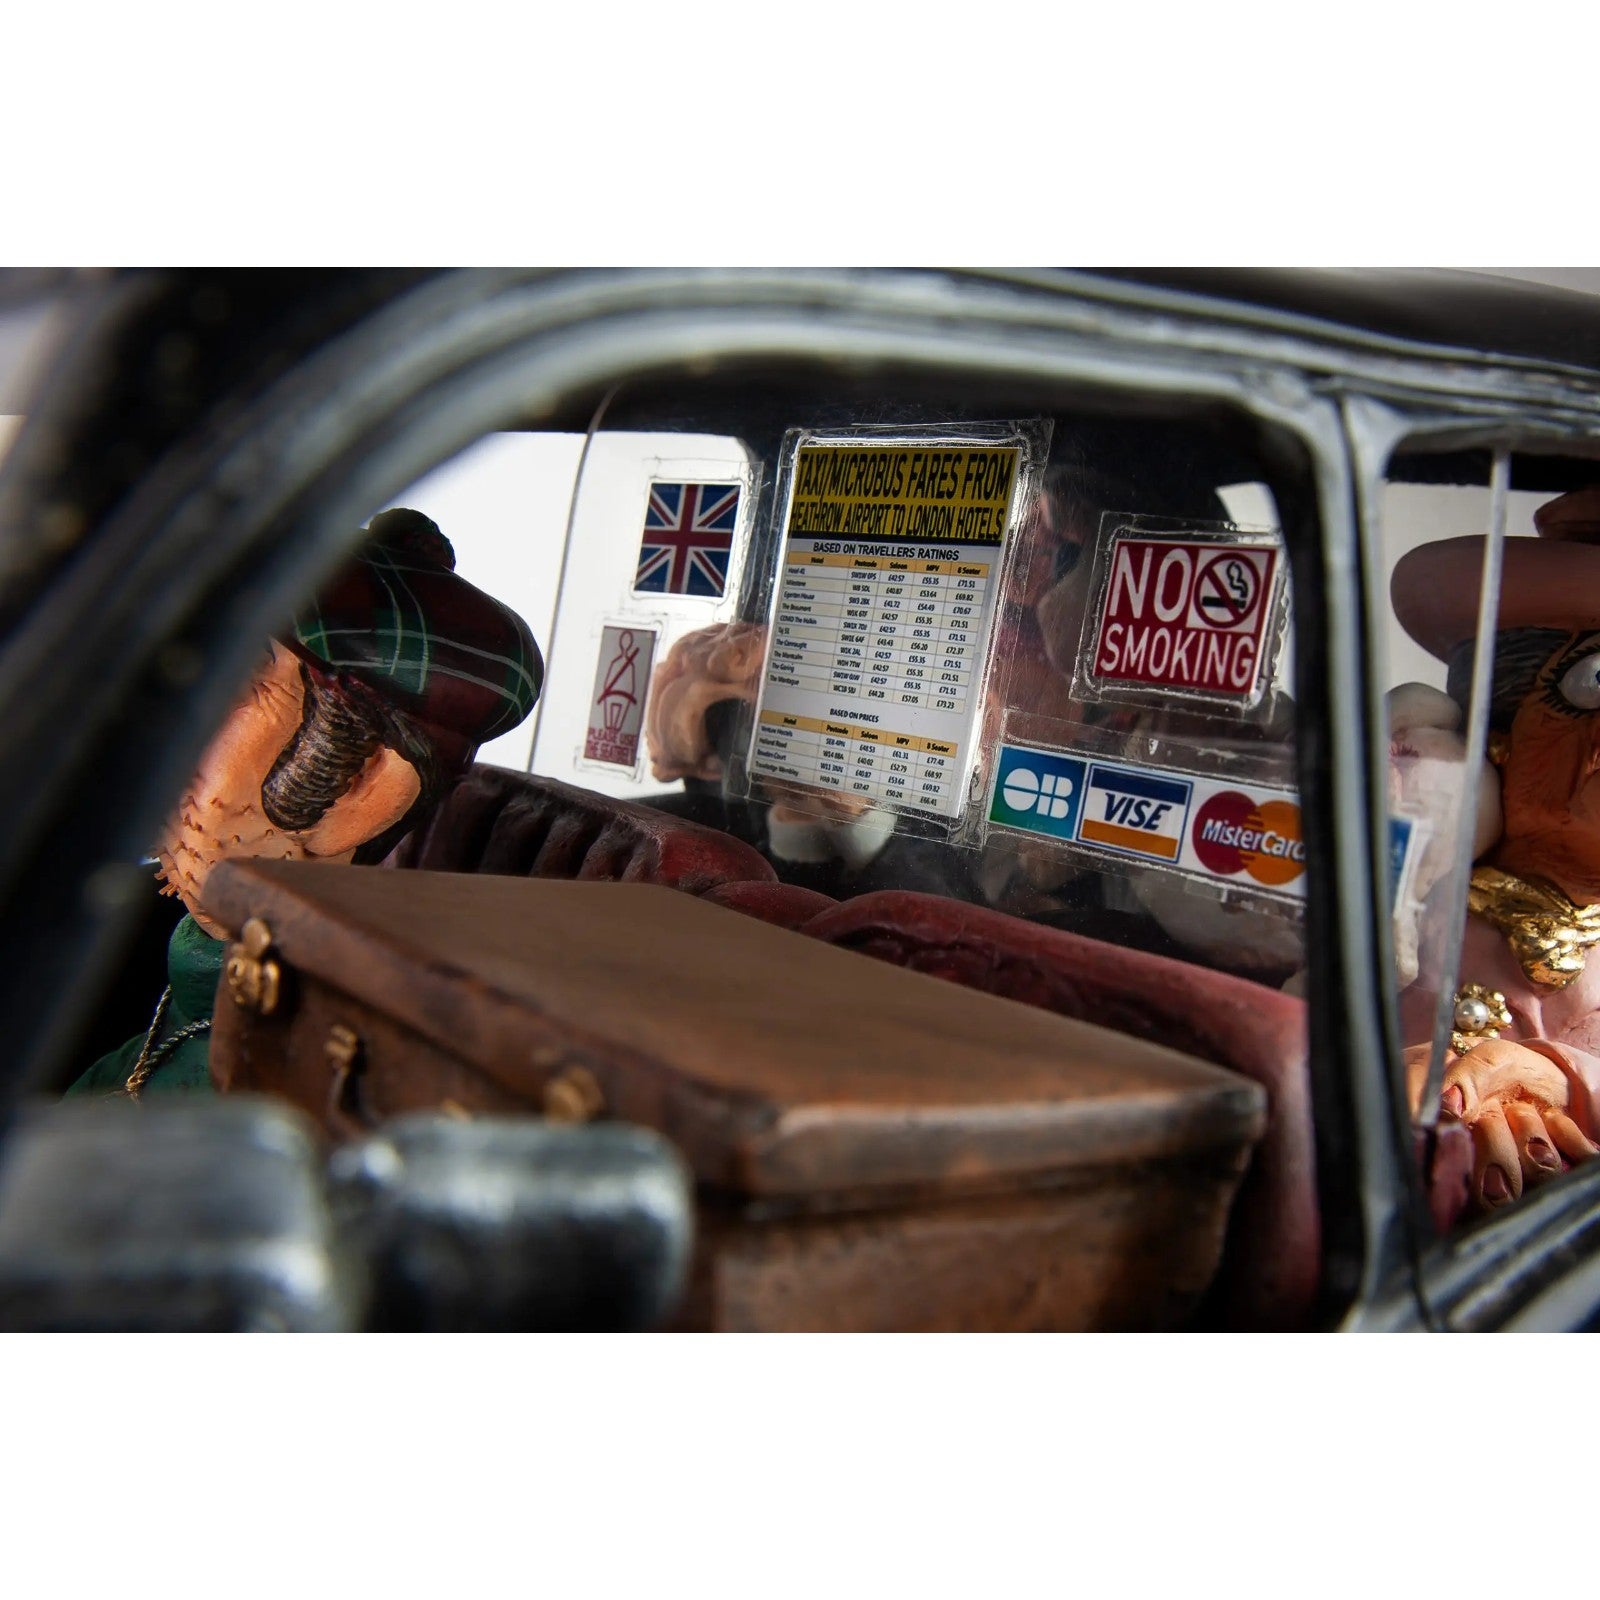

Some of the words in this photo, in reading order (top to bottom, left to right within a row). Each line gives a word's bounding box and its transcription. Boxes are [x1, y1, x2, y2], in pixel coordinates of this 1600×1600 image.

[796, 450, 907, 499] TAXI/MICROBUS
[906, 454, 963, 500] FARES
[961, 454, 1014, 501] FROM
[791, 501, 843, 532] HEATHROW
[843, 504, 891, 534] AIRPORT
[893, 505, 906, 535] TO
[906, 504, 953, 537] LONDON
[955, 506, 1005, 540] HOTELS
[814, 542, 840, 553] BASED
[843, 544, 855, 554] ON
[858, 545, 915, 558] TRAVELLERS
[917, 548, 959, 560] RATINGS
[922, 577, 939, 585] £55.35
[958, 580, 975, 588] £71.51
[1108, 546, 1192, 622] NO
[951, 620, 968, 628] £71.51
[949, 633, 966, 641] £71.51
[911, 642, 928, 650] £56.20
[909, 655, 925, 664] £55.35
[944, 660, 961, 668] £71.51
[1101, 623, 1255, 688] SMOKING
[907, 669, 923, 677] £55.35
[941, 673, 959, 681] £71.51
[904, 681, 921, 690] £55.35
[939, 686, 956, 695] £71.51
[902, 695, 918, 703] £57.05
[937, 700, 954, 709] £73.23
[830, 708, 848, 718] BASED
[859, 713, 879, 723] PRICES
[861, 731, 878, 739] Saloon
[896, 737, 909, 745] MPV
[927, 757, 944, 766] £77.48
[890, 764, 907, 772] £52.79
[925, 770, 942, 779] £68.97
[1104, 792, 1172, 830] VISE
